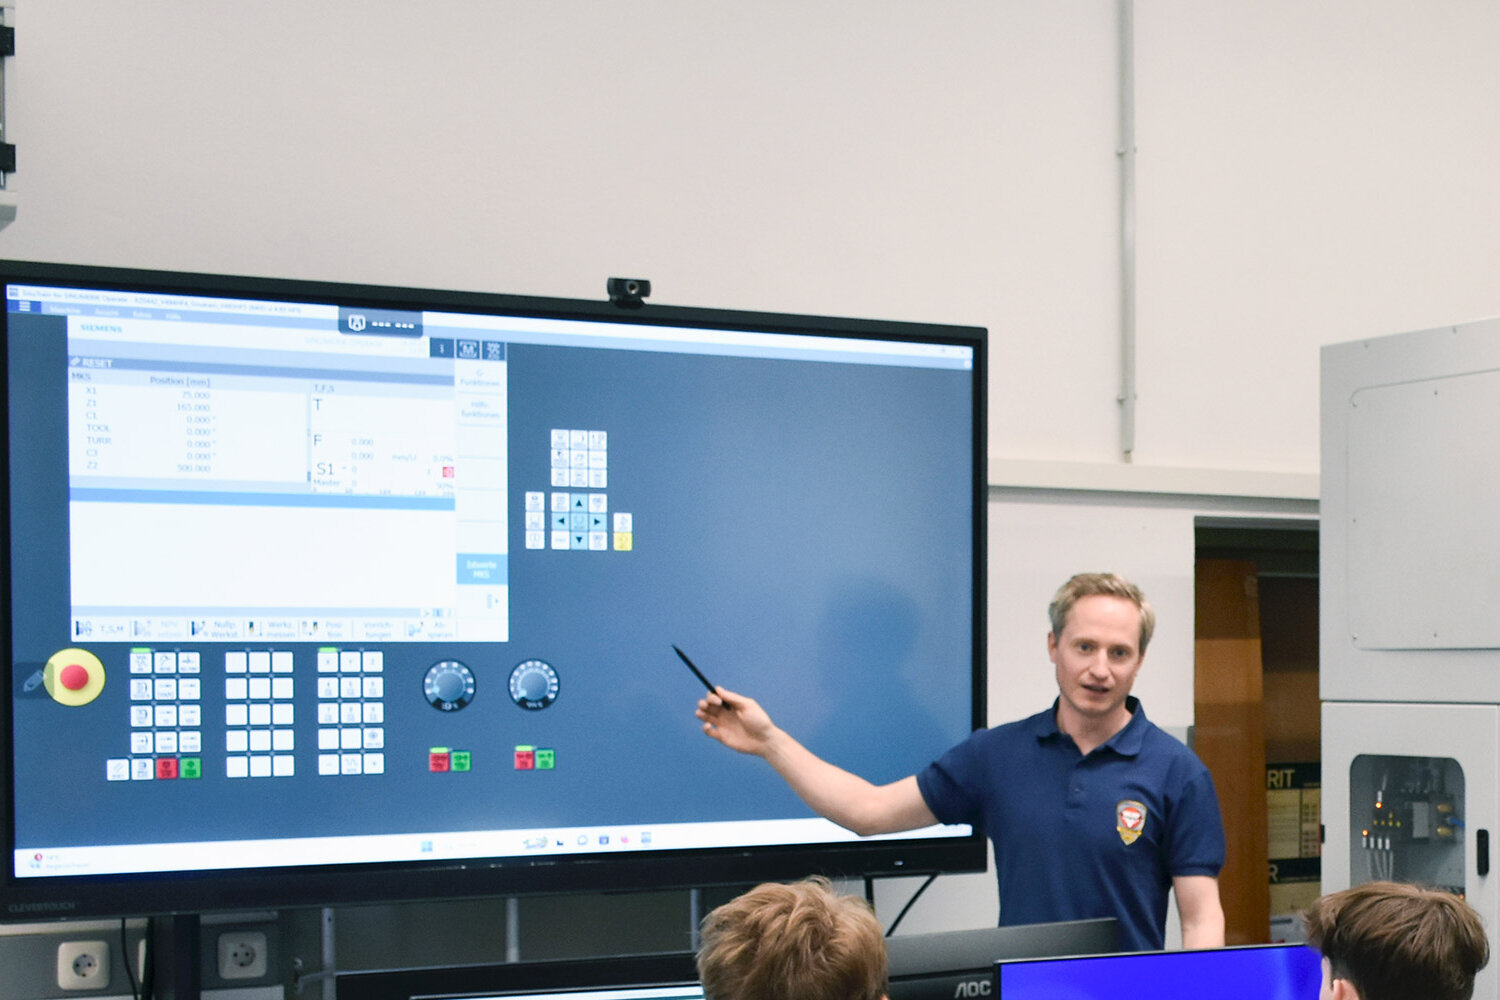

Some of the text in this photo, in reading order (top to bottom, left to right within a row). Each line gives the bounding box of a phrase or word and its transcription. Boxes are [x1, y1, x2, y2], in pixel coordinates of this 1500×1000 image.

[80, 324, 122, 334] SIEMENS
[83, 359, 112, 368] RESET
[71, 373, 211, 388] MKS Position [mm]
[313, 398, 323, 411] T
[87, 424, 111, 432] TOOL
[313, 434, 323, 446] F
[316, 462, 334, 475] S1
[1267, 769, 1295, 788] RIT
[954, 980, 992, 999] AOC
